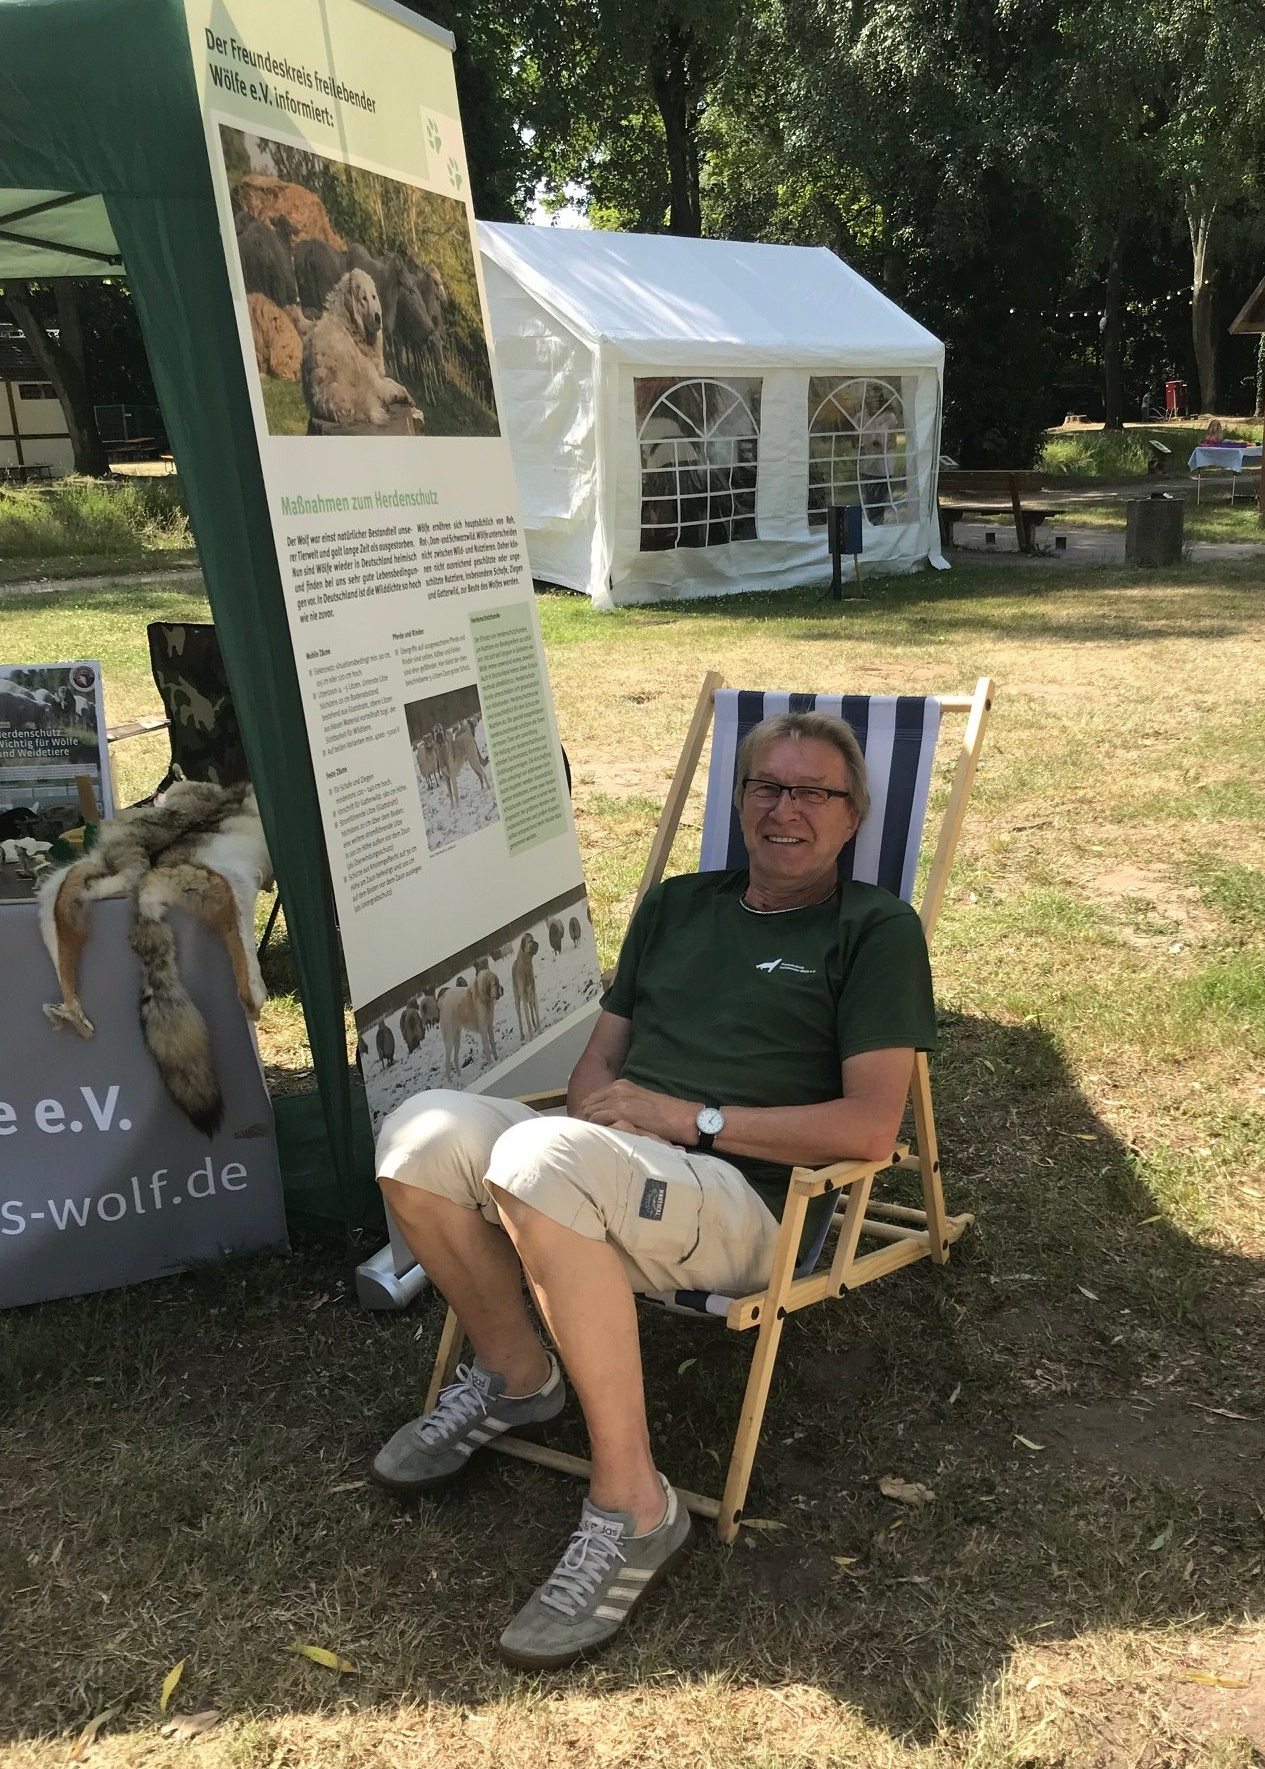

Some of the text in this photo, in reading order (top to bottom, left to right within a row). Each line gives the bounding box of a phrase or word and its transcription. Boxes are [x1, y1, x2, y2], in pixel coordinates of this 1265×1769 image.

[205, 27, 376, 114] Der Freundeskreis freilebender
[209, 64, 334, 127] Wölfe e.V. informiert:
[280, 489, 438, 516] Maßnahmen zum Herdenschutz
[286, 536, 296, 546] Der
[296, 535, 310, 546] Wolf
[321, 532, 336, 542] einst
[336, 530, 367, 540] natürlicher
[367, 526, 397, 537] Bestandteil
[297, 549, 318, 560] Tierwelt
[319, 548, 330, 558] und
[330, 546, 342, 558] galt
[342, 546, 358, 556] lange
[358, 543, 370, 553] Zeit
[370, 543, 378, 551] als
[378, 539, 414, 551] ausgestorben.
[291, 567, 302, 576] Nun
[303, 565, 314, 575] sind
[315, 563, 332, 574] Wölfe
[333, 561, 353, 571] wieder
[360, 555, 392, 567] Deutschland
[393, 552, 417, 562] heimisch
[294, 582, 304, 592] und
[305, 580, 322, 593] finden
[324, 577, 334, 587] bei
[347, 574, 360, 584] sehr
[361, 572, 374, 584] gute
[375, 567, 418, 579] Lebensbedingun-
[296, 599, 307, 610] gen
[322, 589, 358, 603] Deutschland
[358, 588, 366, 597] ist
[365, 587, 374, 596] die
[374, 582, 401, 594] Wilddichte
[408, 579, 421, 588] hoch
[299, 613, 309, 623] wie
[0, 729, 64, 738] erdenschutz:
[36, 738, 49, 747] für
[52, 738, 78, 746] Wölfe
[18, 748, 70, 757] Weidetiere
[35, 1086, 132, 1133] e.V.
